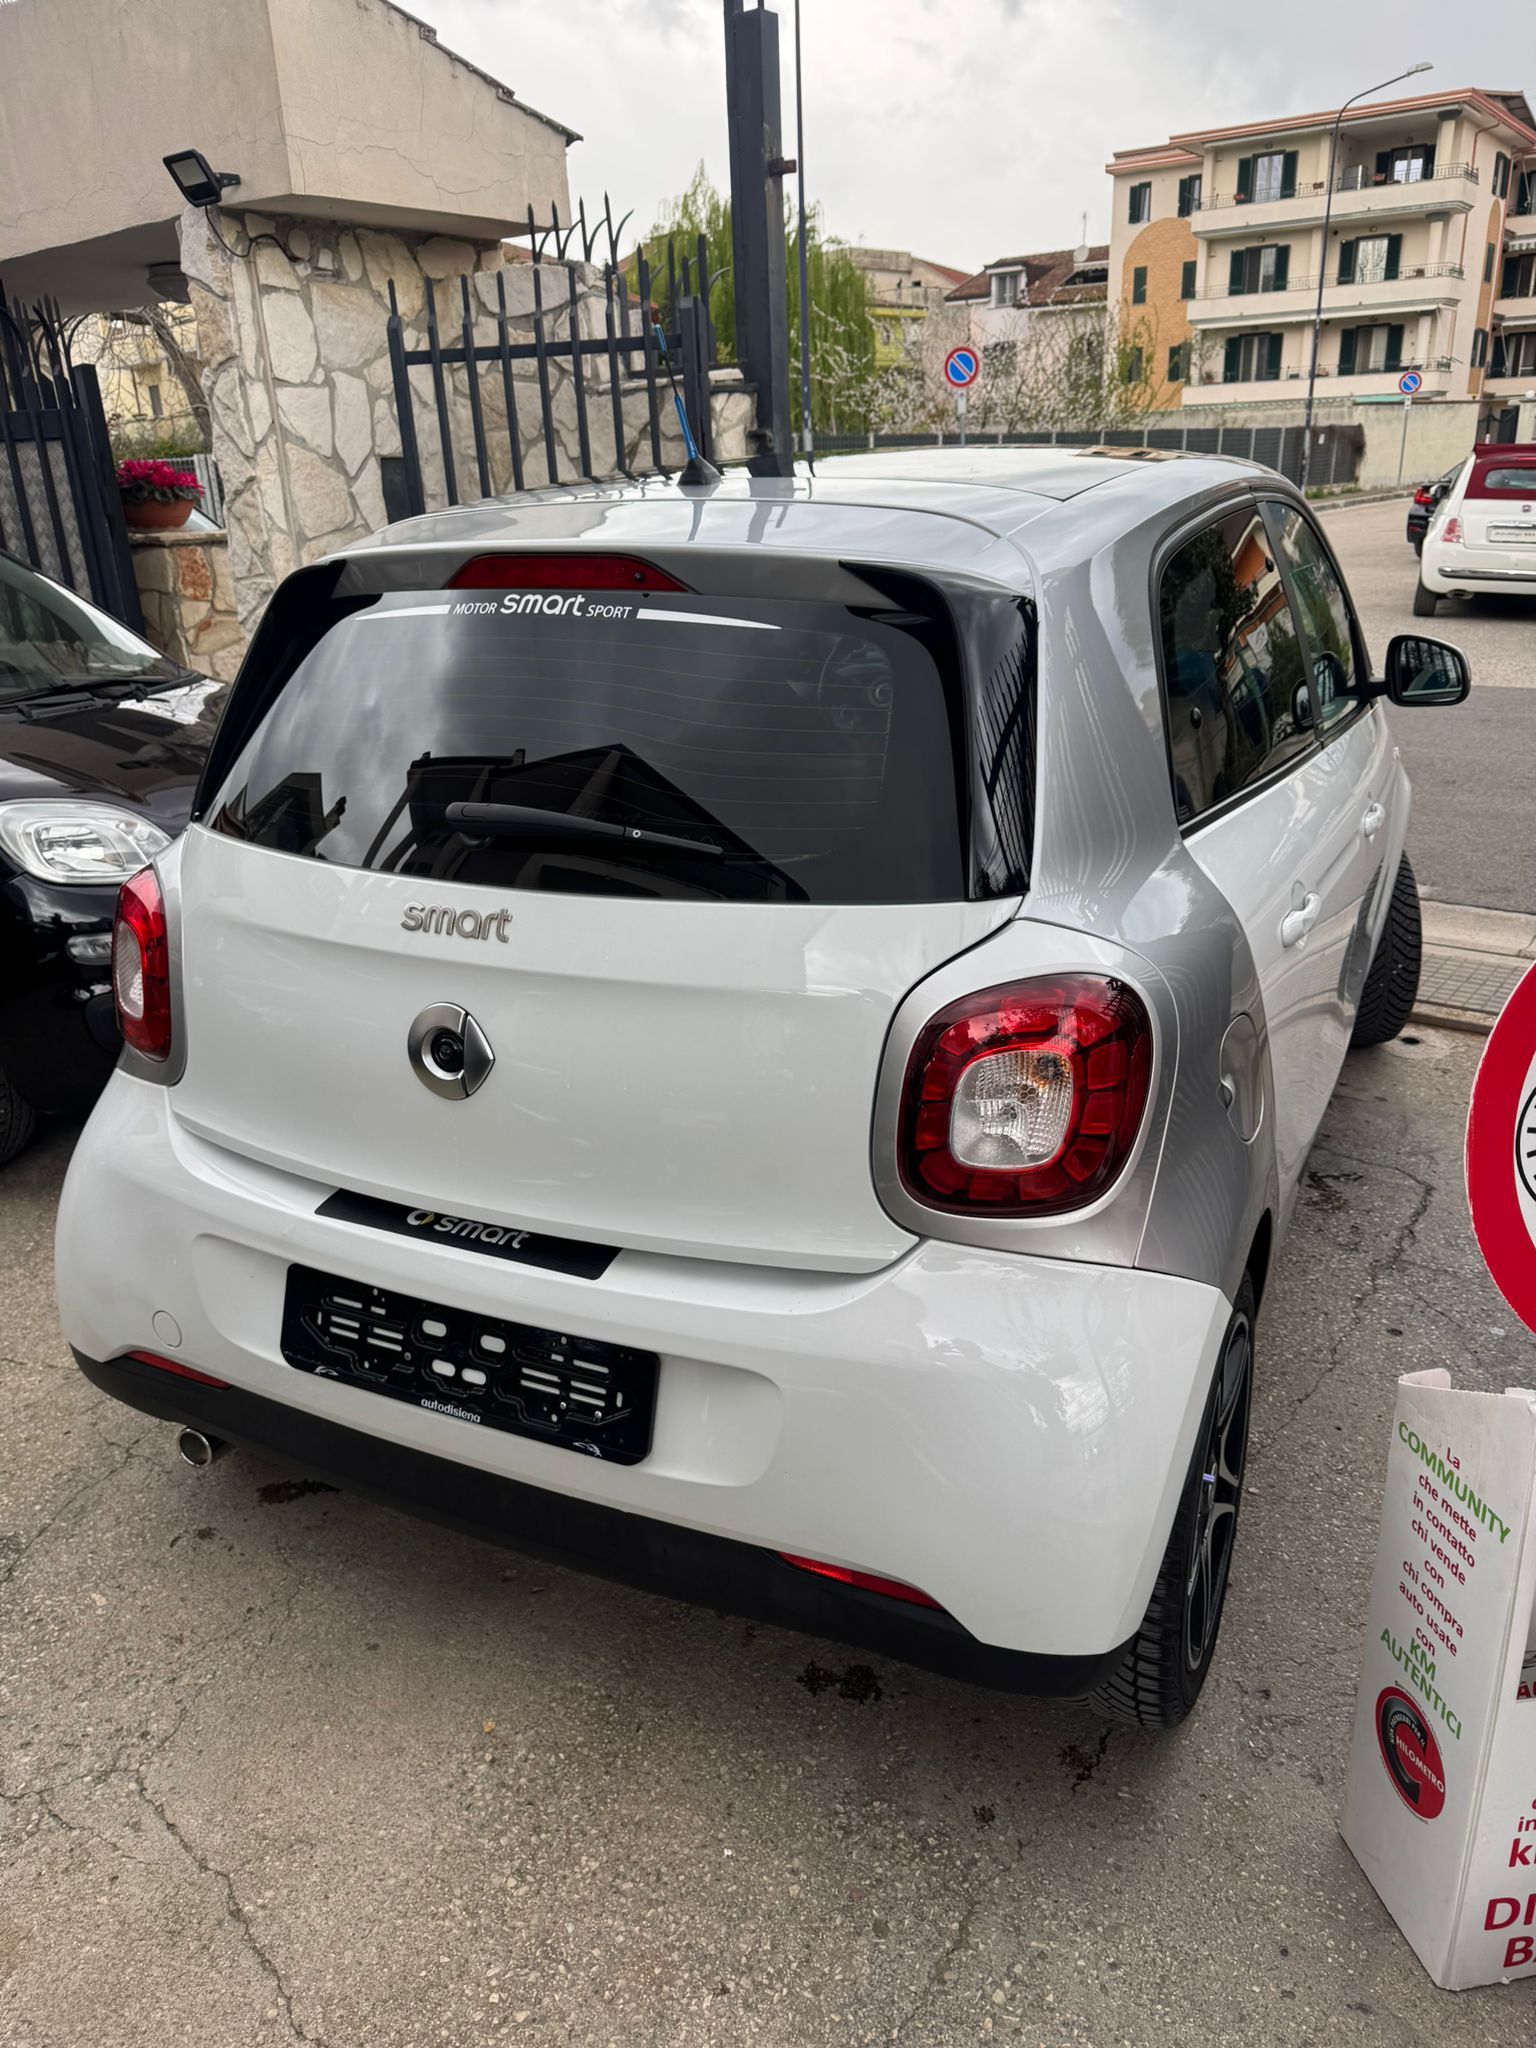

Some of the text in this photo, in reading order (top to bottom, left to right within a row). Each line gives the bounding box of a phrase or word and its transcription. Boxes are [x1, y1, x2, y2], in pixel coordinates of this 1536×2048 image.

[453, 594, 632, 619] MOTOR smart SPORT
[400, 901, 514, 944] smart
[433, 1215, 530, 1249] smart
[1399, 1421, 1511, 1544] COMMUNITY
[1446, 1447, 1460, 1470] La
[1413, 1490, 1475, 1568] in contatto
[1419, 1474, 1477, 1542] che mette
[1411, 1519, 1466, 1586] chi vende
[1424, 1560, 1445, 1589] con
[1399, 1581, 1457, 1656] auto usate
[1403, 1561, 1464, 1638] chi compra
[1410, 1637, 1436, 1682] KM
[1416, 1627, 1435, 1656] con
[1381, 1628, 1462, 1740] AUTENTICI
